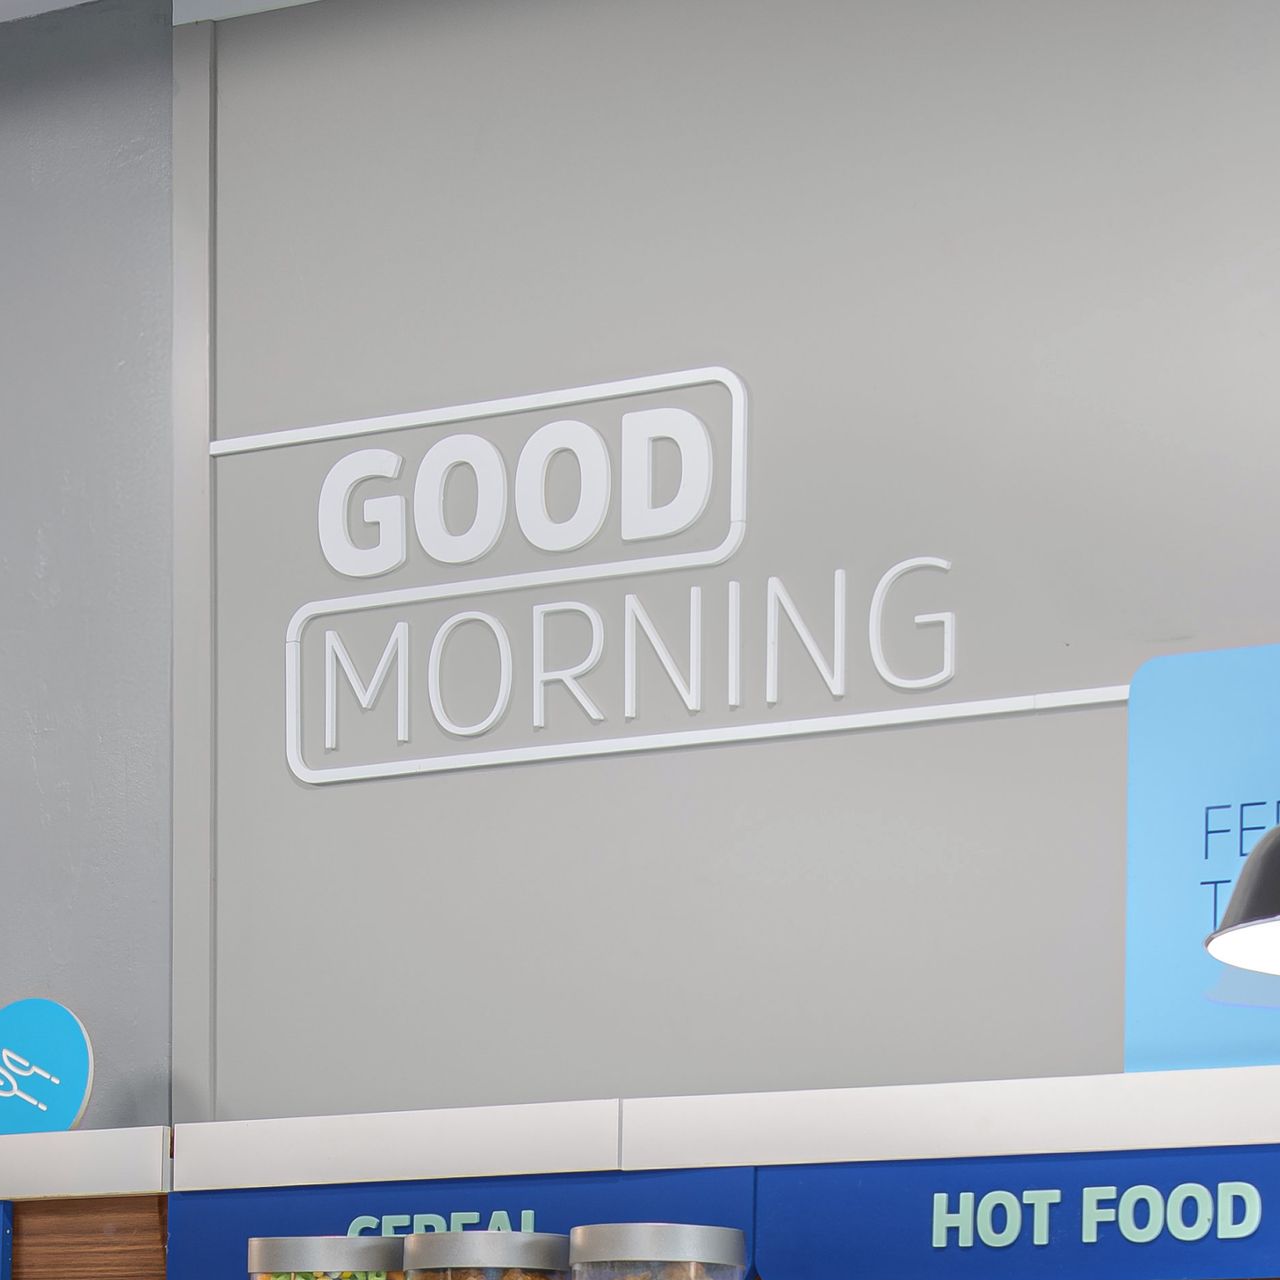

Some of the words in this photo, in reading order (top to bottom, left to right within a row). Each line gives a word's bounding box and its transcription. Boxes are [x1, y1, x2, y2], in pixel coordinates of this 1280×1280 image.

[318, 407, 714, 578] GOOD
[323, 556, 956, 751] MORNING
[932, 1189, 1061, 1248] HOT
[1081, 1181, 1263, 1244] FOOD
